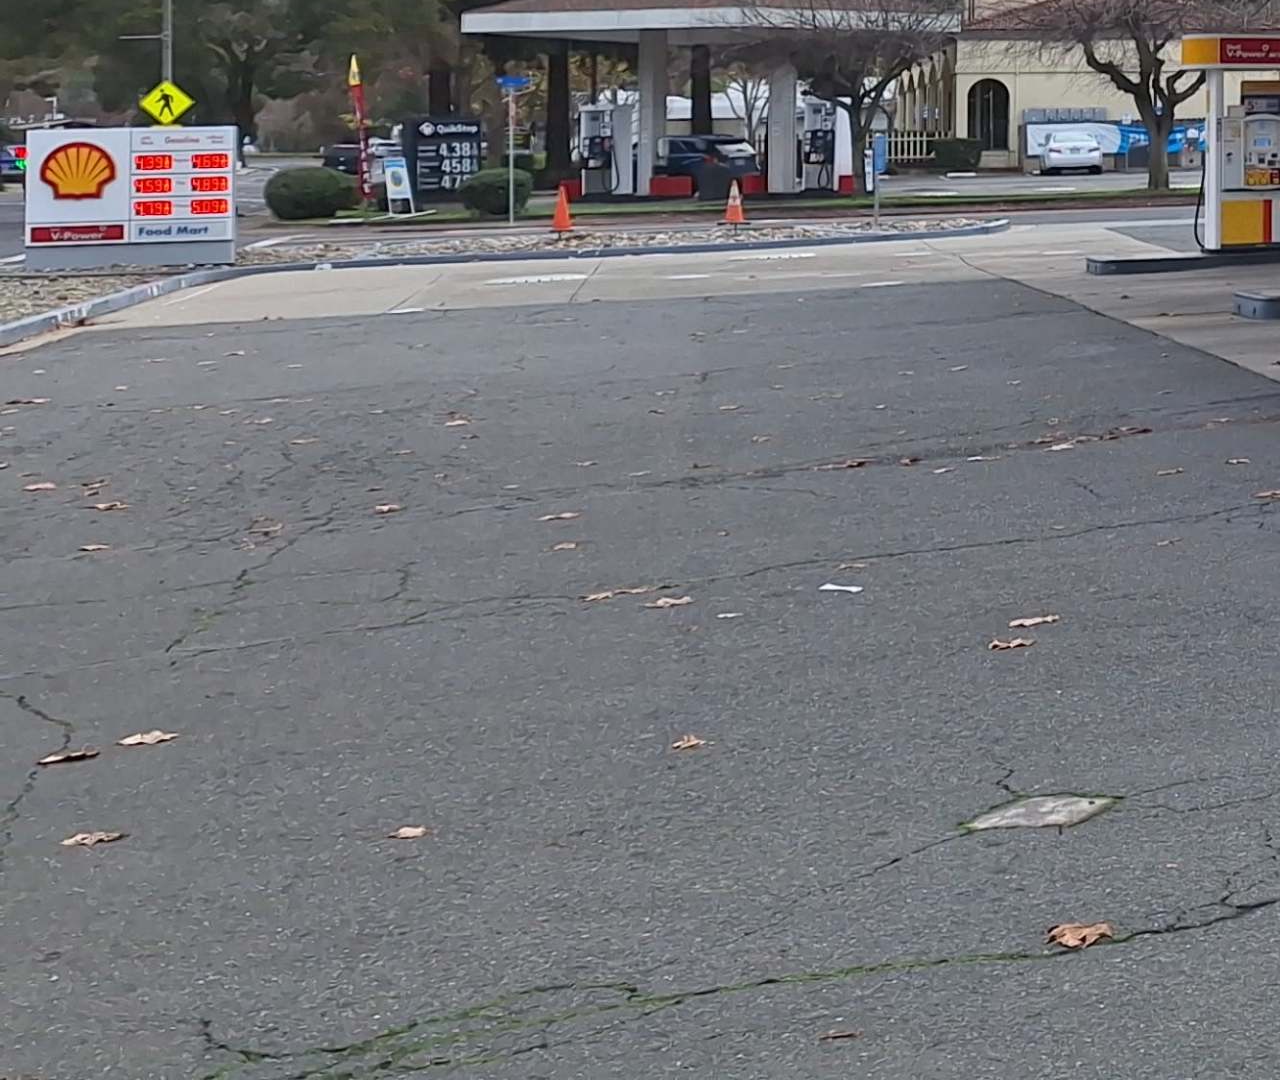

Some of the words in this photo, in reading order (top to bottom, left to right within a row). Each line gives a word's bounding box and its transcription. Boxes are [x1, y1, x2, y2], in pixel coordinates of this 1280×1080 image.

[51, 230, 105, 241] V-Power
[138, 226, 172, 236] Food
[176, 224, 209, 235] Mart
